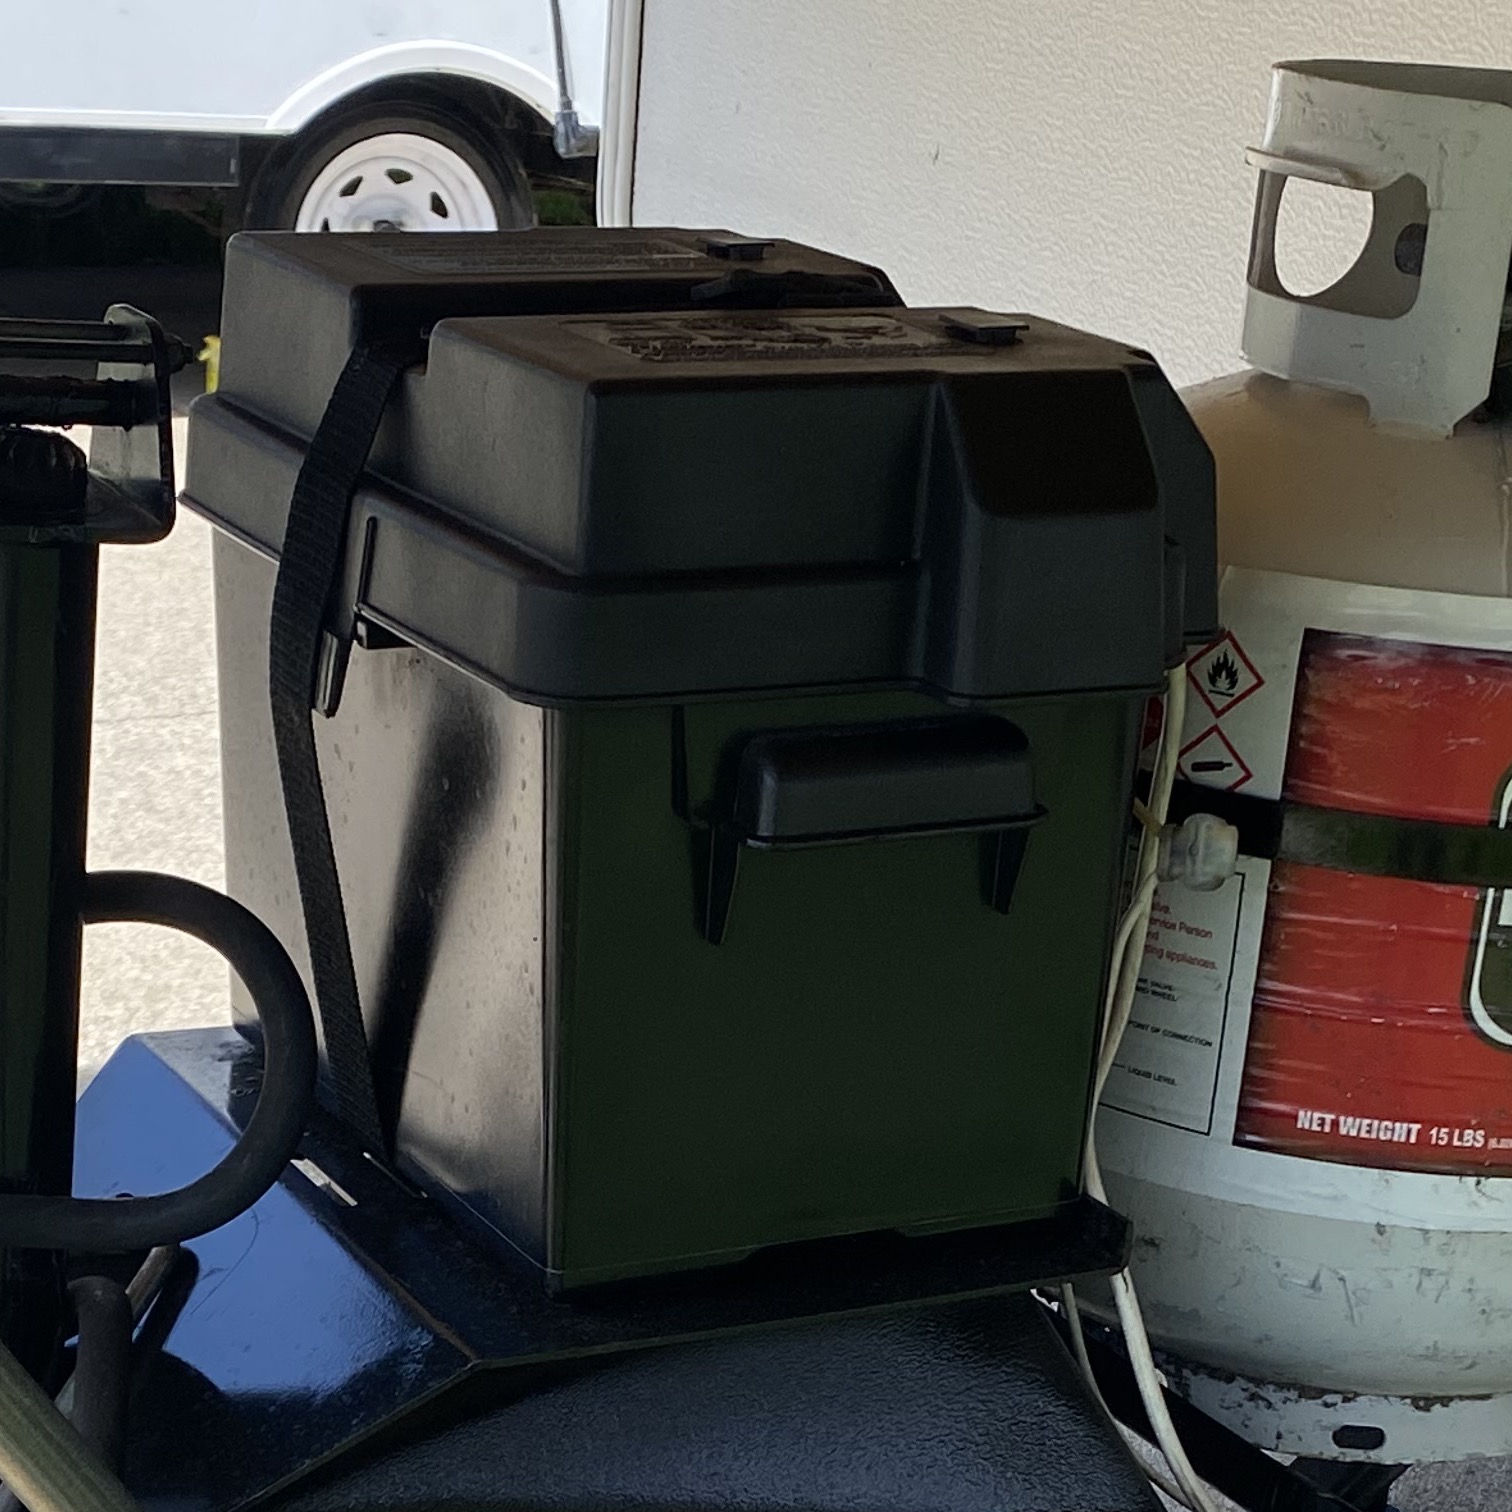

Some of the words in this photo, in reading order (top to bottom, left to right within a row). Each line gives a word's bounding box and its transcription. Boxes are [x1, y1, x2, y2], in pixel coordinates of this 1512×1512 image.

[1178, 922, 1213, 939] Person
[1162, 1028, 1213, 1047] CONNECTION
[1296, 1108, 1336, 1133] NET
[1338, 1115, 1422, 1144] WEIGHT
[1429, 1127, 1449, 1146] 15
[1453, 1128, 1486, 1148] LBS
